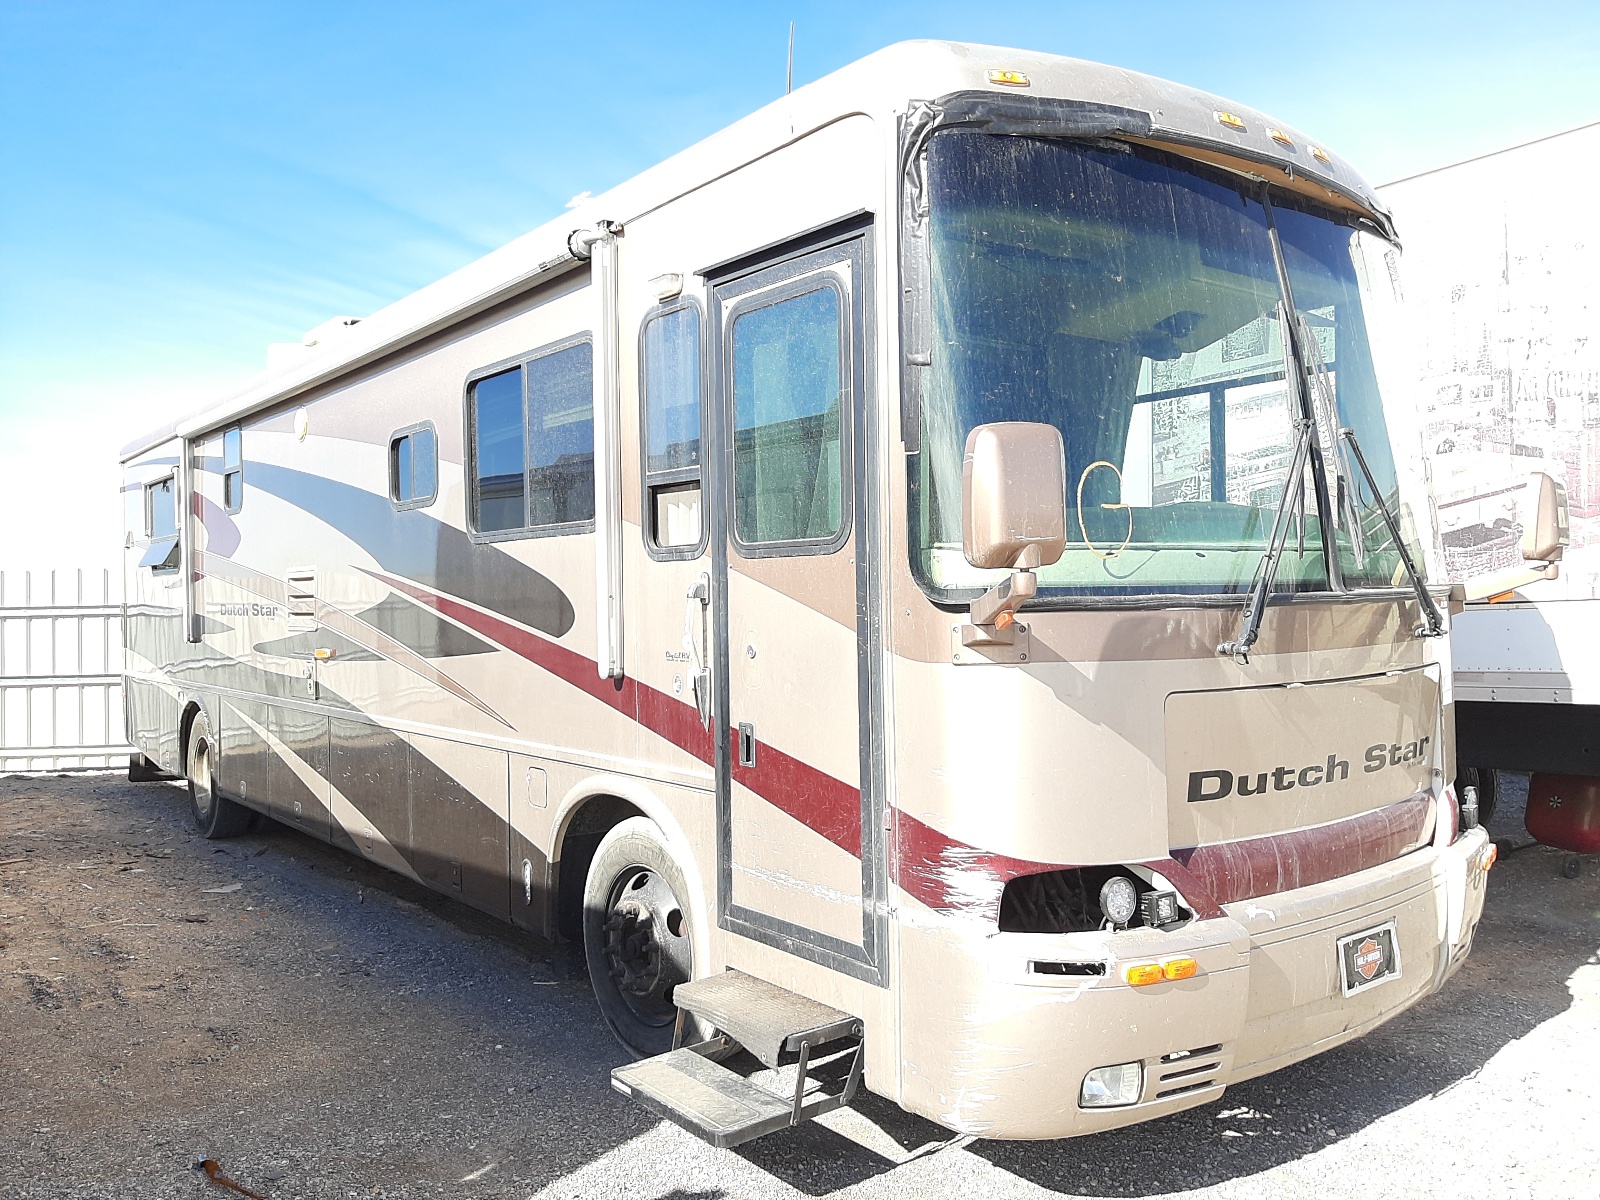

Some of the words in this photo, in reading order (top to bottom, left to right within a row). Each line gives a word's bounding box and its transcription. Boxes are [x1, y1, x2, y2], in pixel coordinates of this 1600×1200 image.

[220, 603, 249, 616] Dutch
[251, 603, 278, 617] Star
[1186, 753, 1350, 803] Dutch
[1363, 735, 1430, 774] Star
